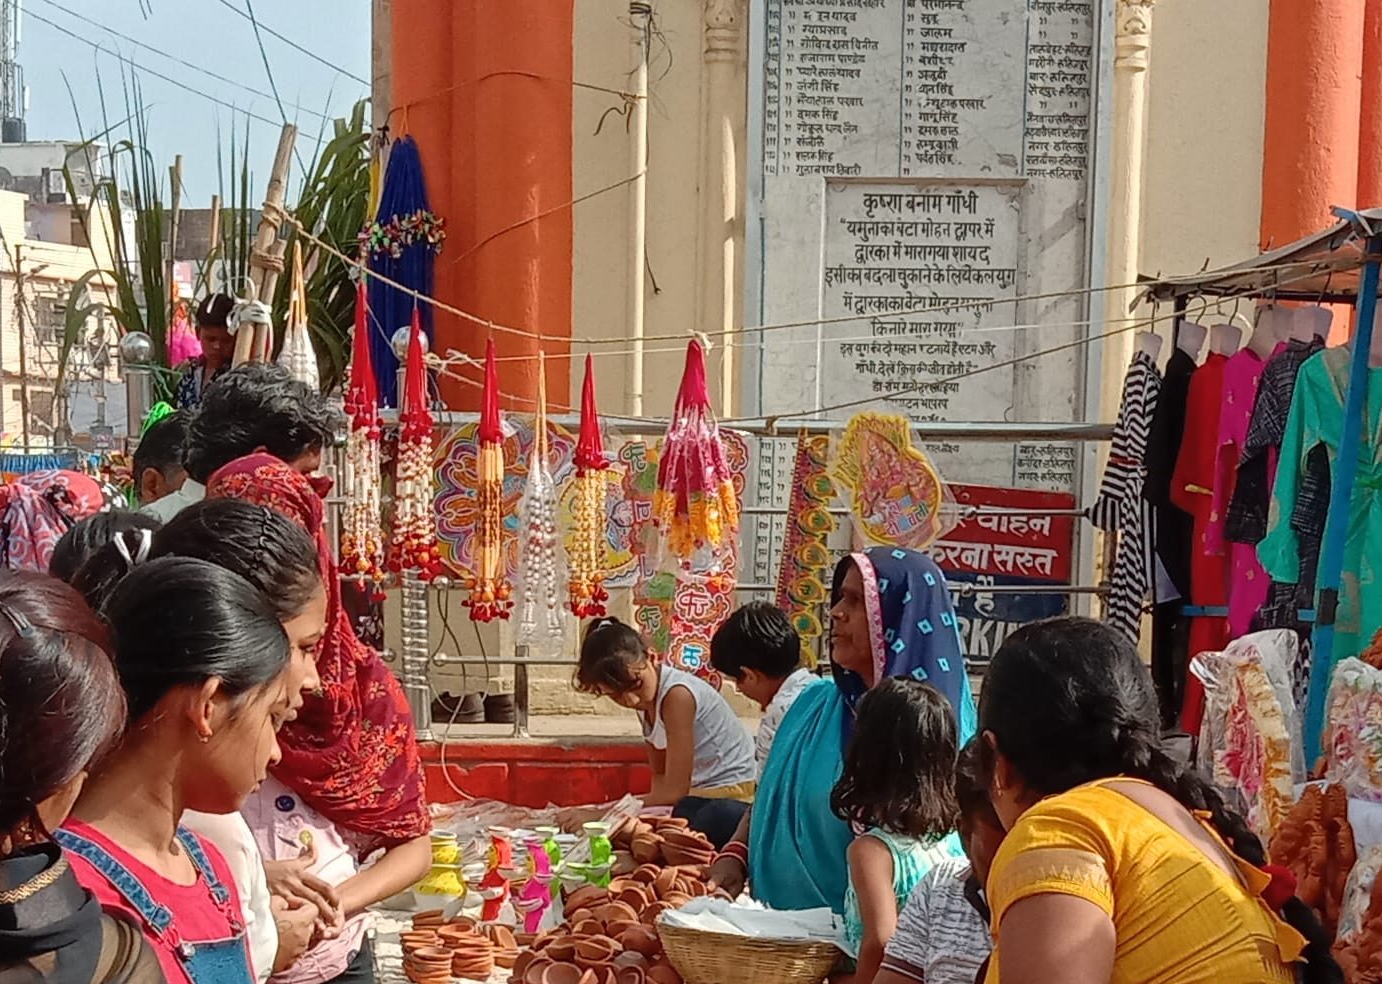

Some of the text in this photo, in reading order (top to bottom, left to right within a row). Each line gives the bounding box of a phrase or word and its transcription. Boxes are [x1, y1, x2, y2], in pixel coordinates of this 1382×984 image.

[905, 194, 944, 213] बनाम
[945, 190, 979, 214] गाँधी
[921, 218, 951, 238] मोहन
[983, 218, 995, 238] में
[854, 244, 890, 265] द्वारका
[891, 241, 902, 260] में
[952, 245, 991, 265] शायद
[864, 268, 896, 286] बदला
[843, 291, 853, 311] में
[870, 316, 907, 336] किनारे
[976, 505, 1052, 538] वाहन
